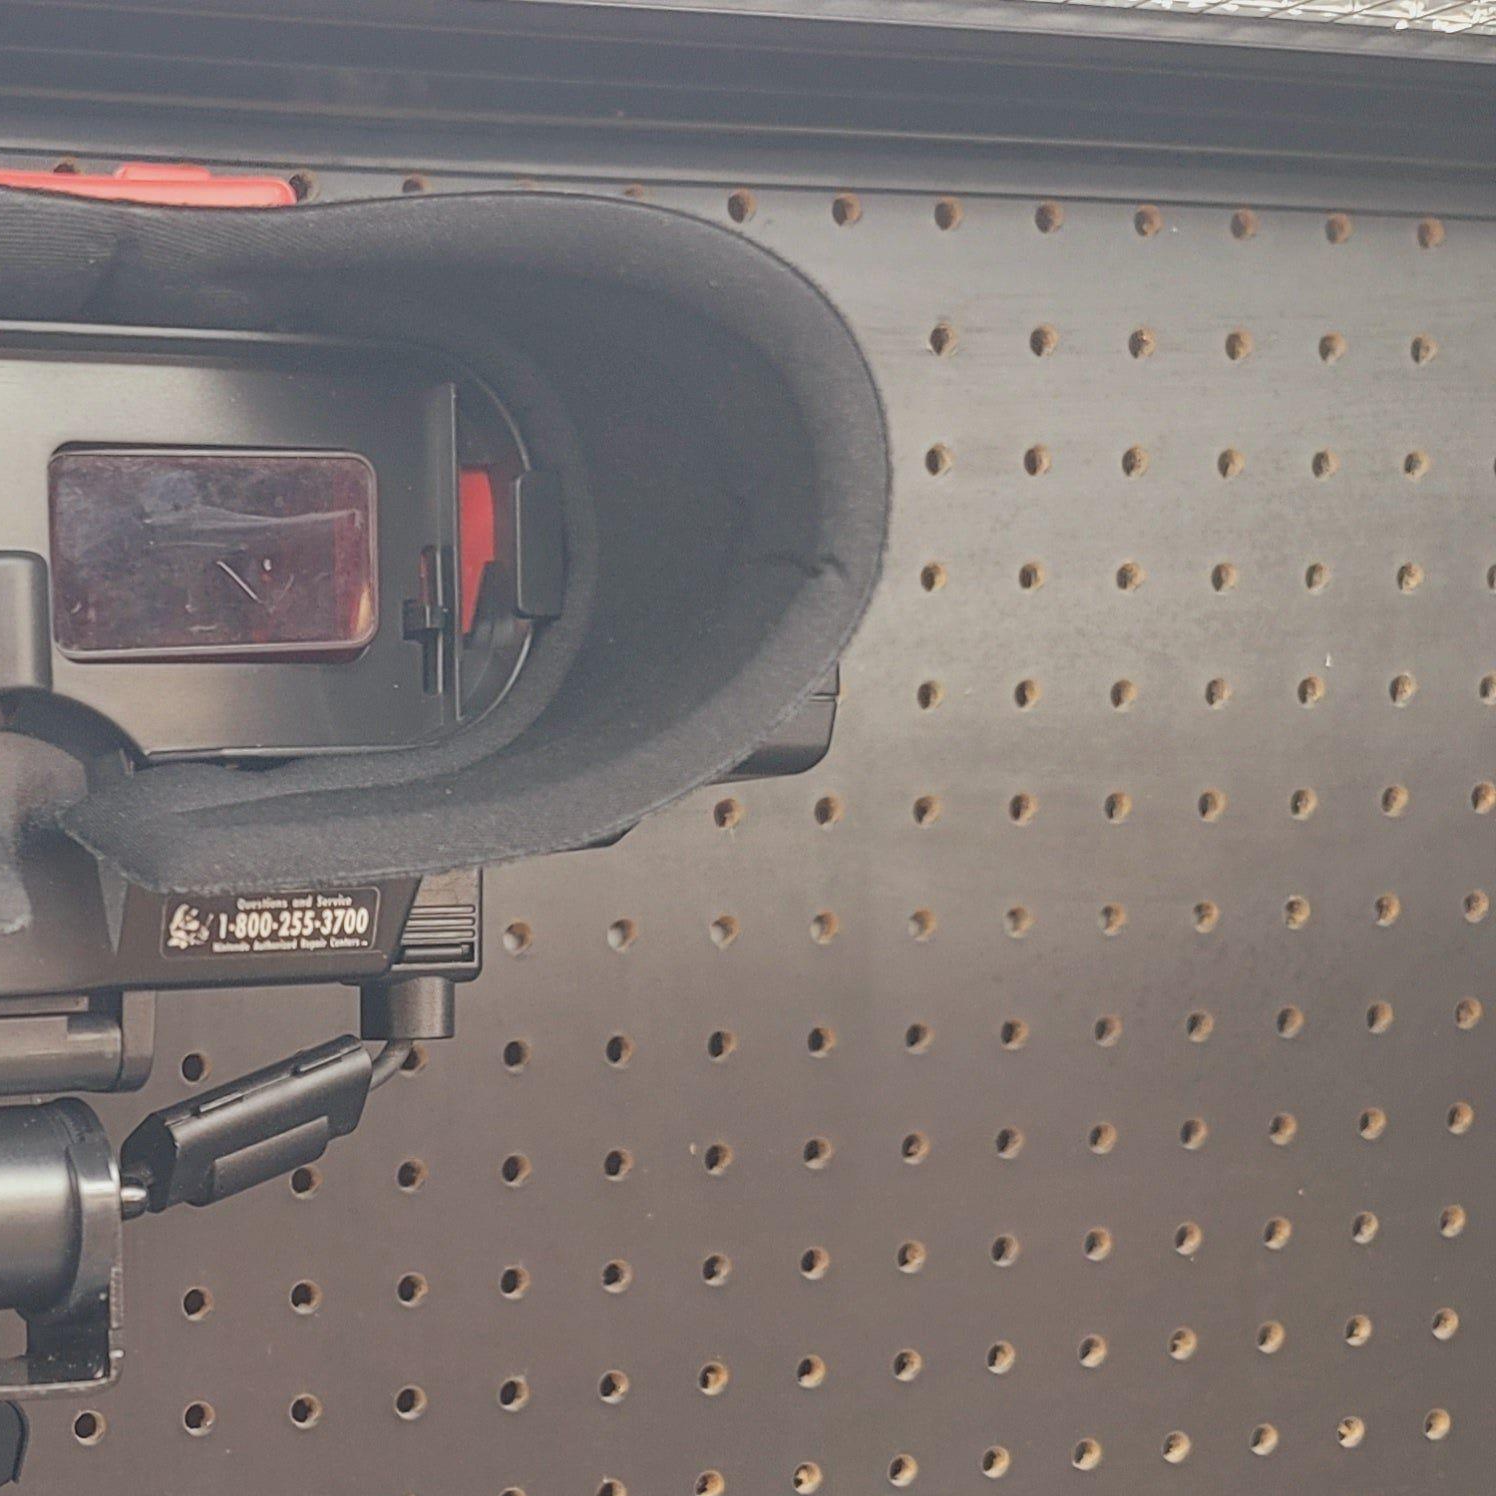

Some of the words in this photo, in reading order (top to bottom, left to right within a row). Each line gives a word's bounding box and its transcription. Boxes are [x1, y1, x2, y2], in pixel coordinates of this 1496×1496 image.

[292, 894, 313, 908] and
[316, 894, 352, 908] Service
[218, 907, 370, 940] 1-800-255-3700
